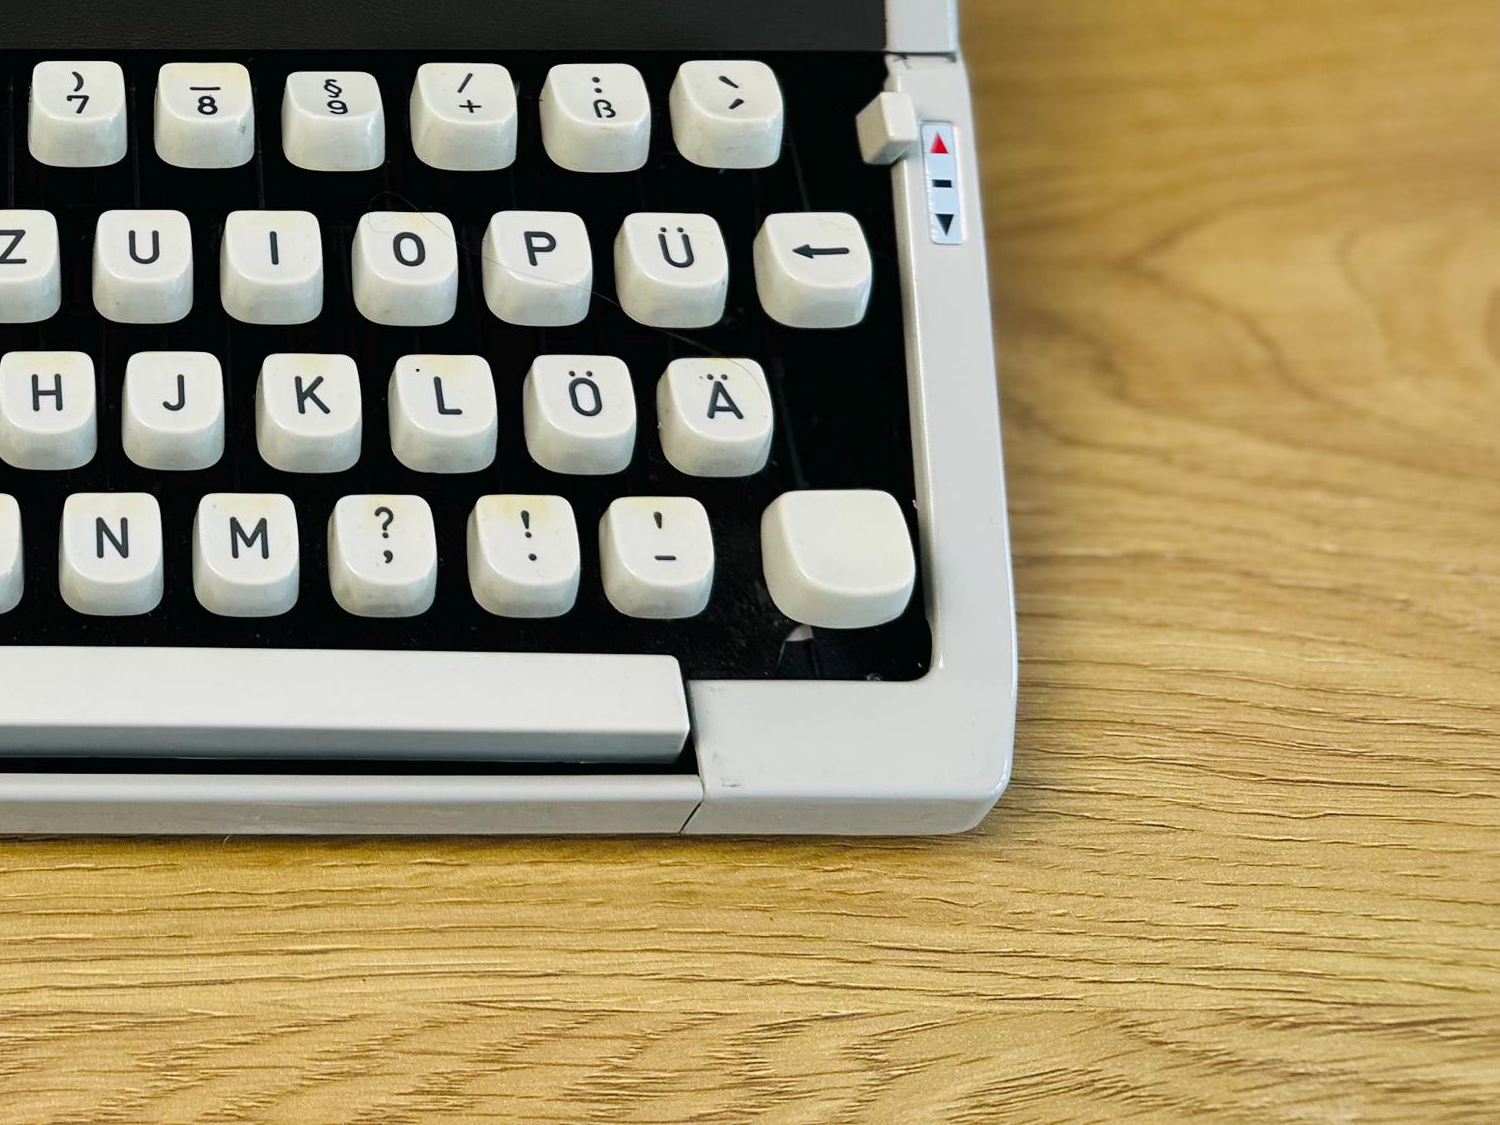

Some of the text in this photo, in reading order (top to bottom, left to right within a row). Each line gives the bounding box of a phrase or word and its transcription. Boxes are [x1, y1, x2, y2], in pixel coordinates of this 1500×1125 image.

[71, 71, 84, 93] )
[323, 78, 343, 99] §
[66, 94, 90, 115] 7
[197, 95, 219, 116] 8
[326, 99, 349, 115] 9
[458, 99, 482, 114] +
[128, 229, 160, 265] U
[269, 230, 279, 266] I
[392, 231, 426, 267] O
[523, 230, 557, 267] P
[657, 226, 695, 269] Ü
[31, 373, 63, 412] H
[162, 374, 186, 412] J
[294, 375, 331, 415] K
[433, 376, 463, 416] L
[568, 370, 603, 417] Ö
[706, 373, 744, 420] Ä
[95, 516, 129, 559] N
[229, 516, 270, 560] M
[374, 506, 394, 539] ?
[520, 510, 532, 539] !
